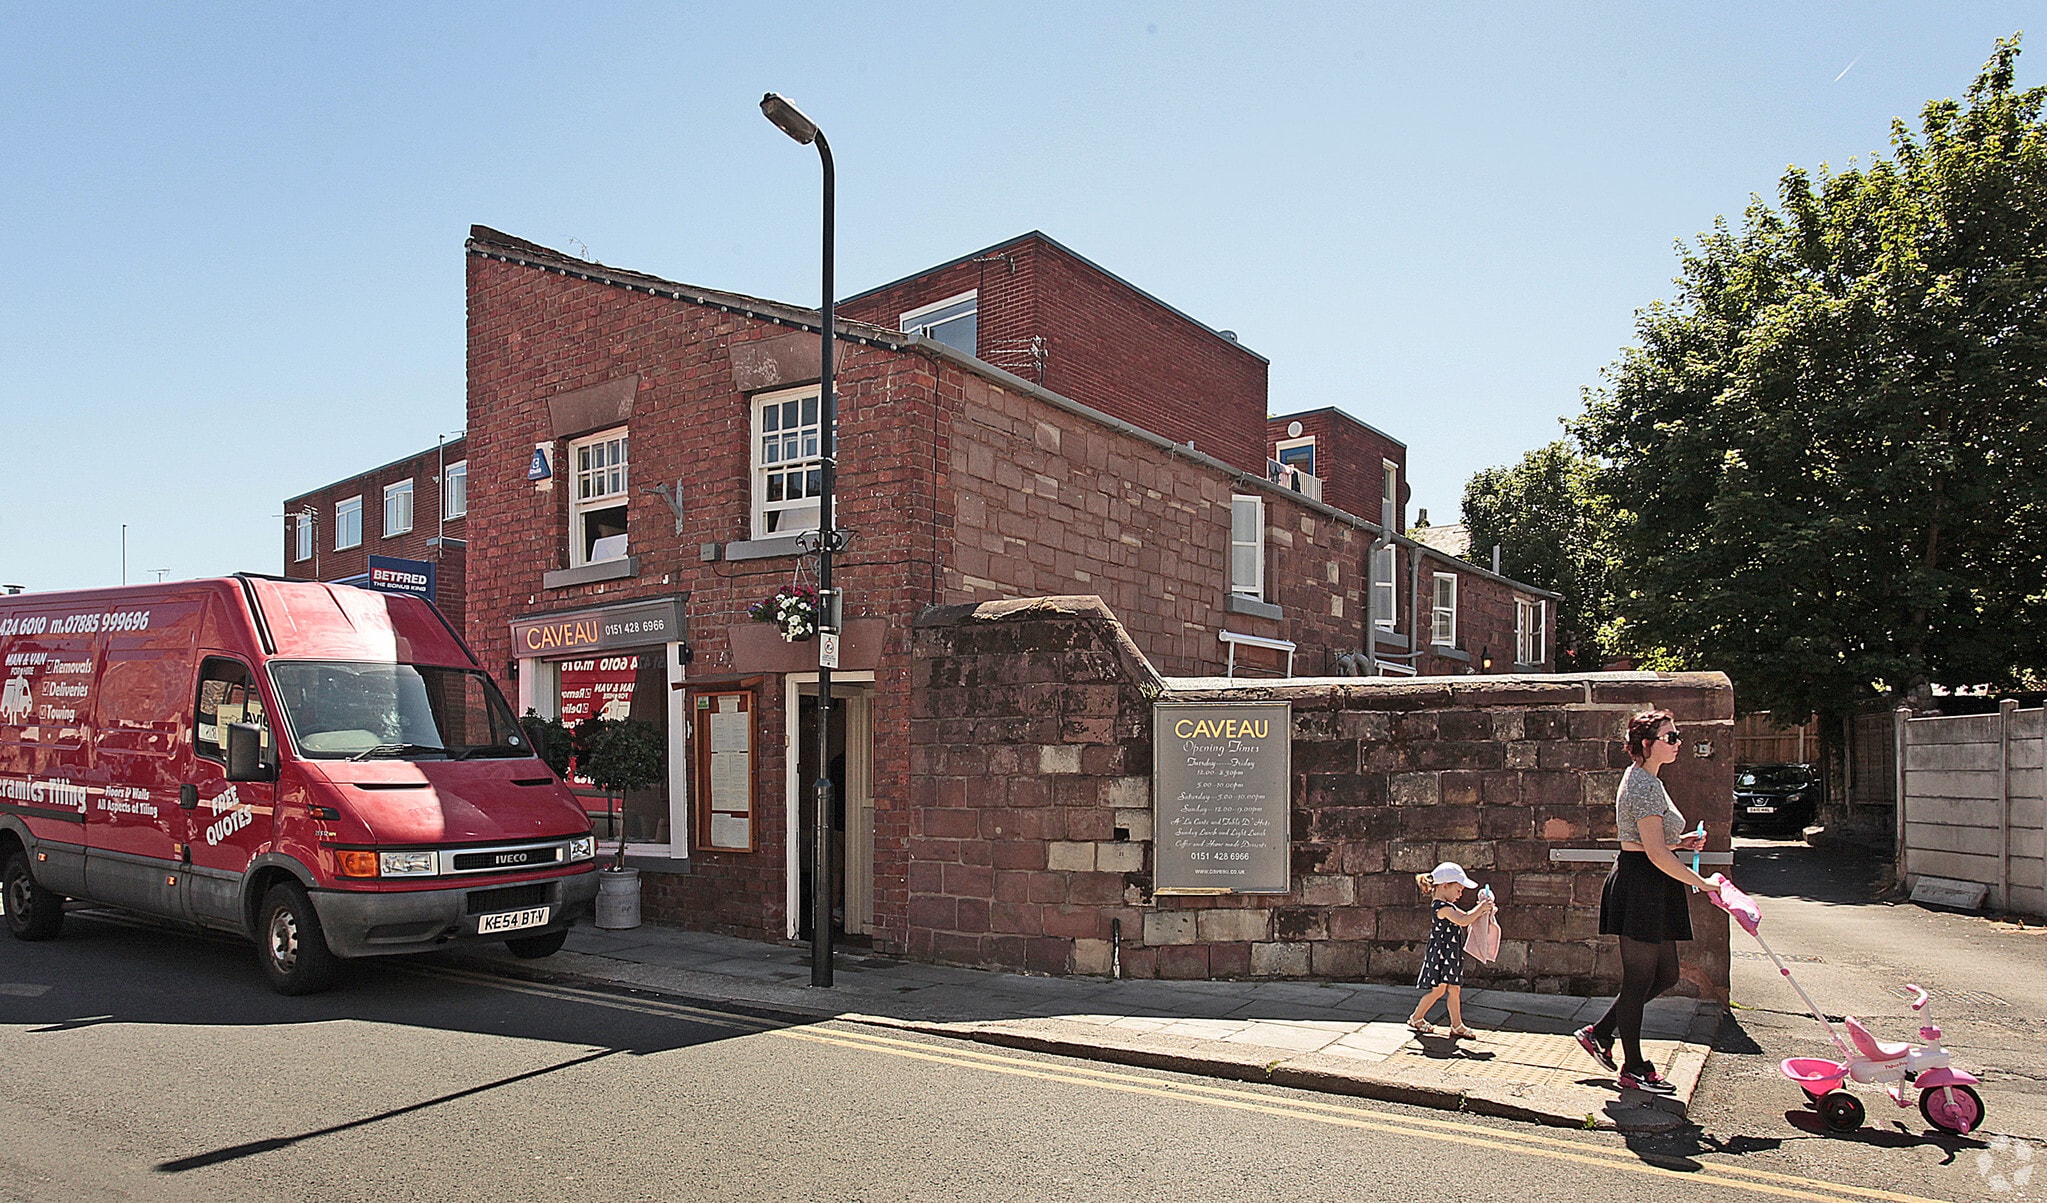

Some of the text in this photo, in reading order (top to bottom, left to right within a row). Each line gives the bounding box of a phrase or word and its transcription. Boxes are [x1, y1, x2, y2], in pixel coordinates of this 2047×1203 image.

[373, 569, 427, 585] BETFRED
[20, 616, 47, 635] 6010
[50, 613, 101, 634] m.07885
[101, 610, 150, 632] 999696
[527, 620, 664, 650] CAVEAU 0151 428 6966
[5, 653, 23, 666] MAN
[30, 652, 48, 665] VAN
[49, 681, 89, 697] Deliveries
[47, 704, 76, 722] Towing
[1174, 719, 1269, 739] CAVEAU
[1183, 740, 1260, 756] Opening Times
[49, 777, 87, 814] Tiling
[105, 786, 124, 798] Floors
[132, 788, 150, 800] Walls
[211, 785, 240, 817] FREE
[97, 799, 158, 818] All Aspects of Tiling
[206, 804, 253, 846] QUOTES
[495, 853, 528, 864] IVECO
[1190, 852, 1250, 861] 0151 428 6966
[484, 909, 546, 931] KE54 BTV
